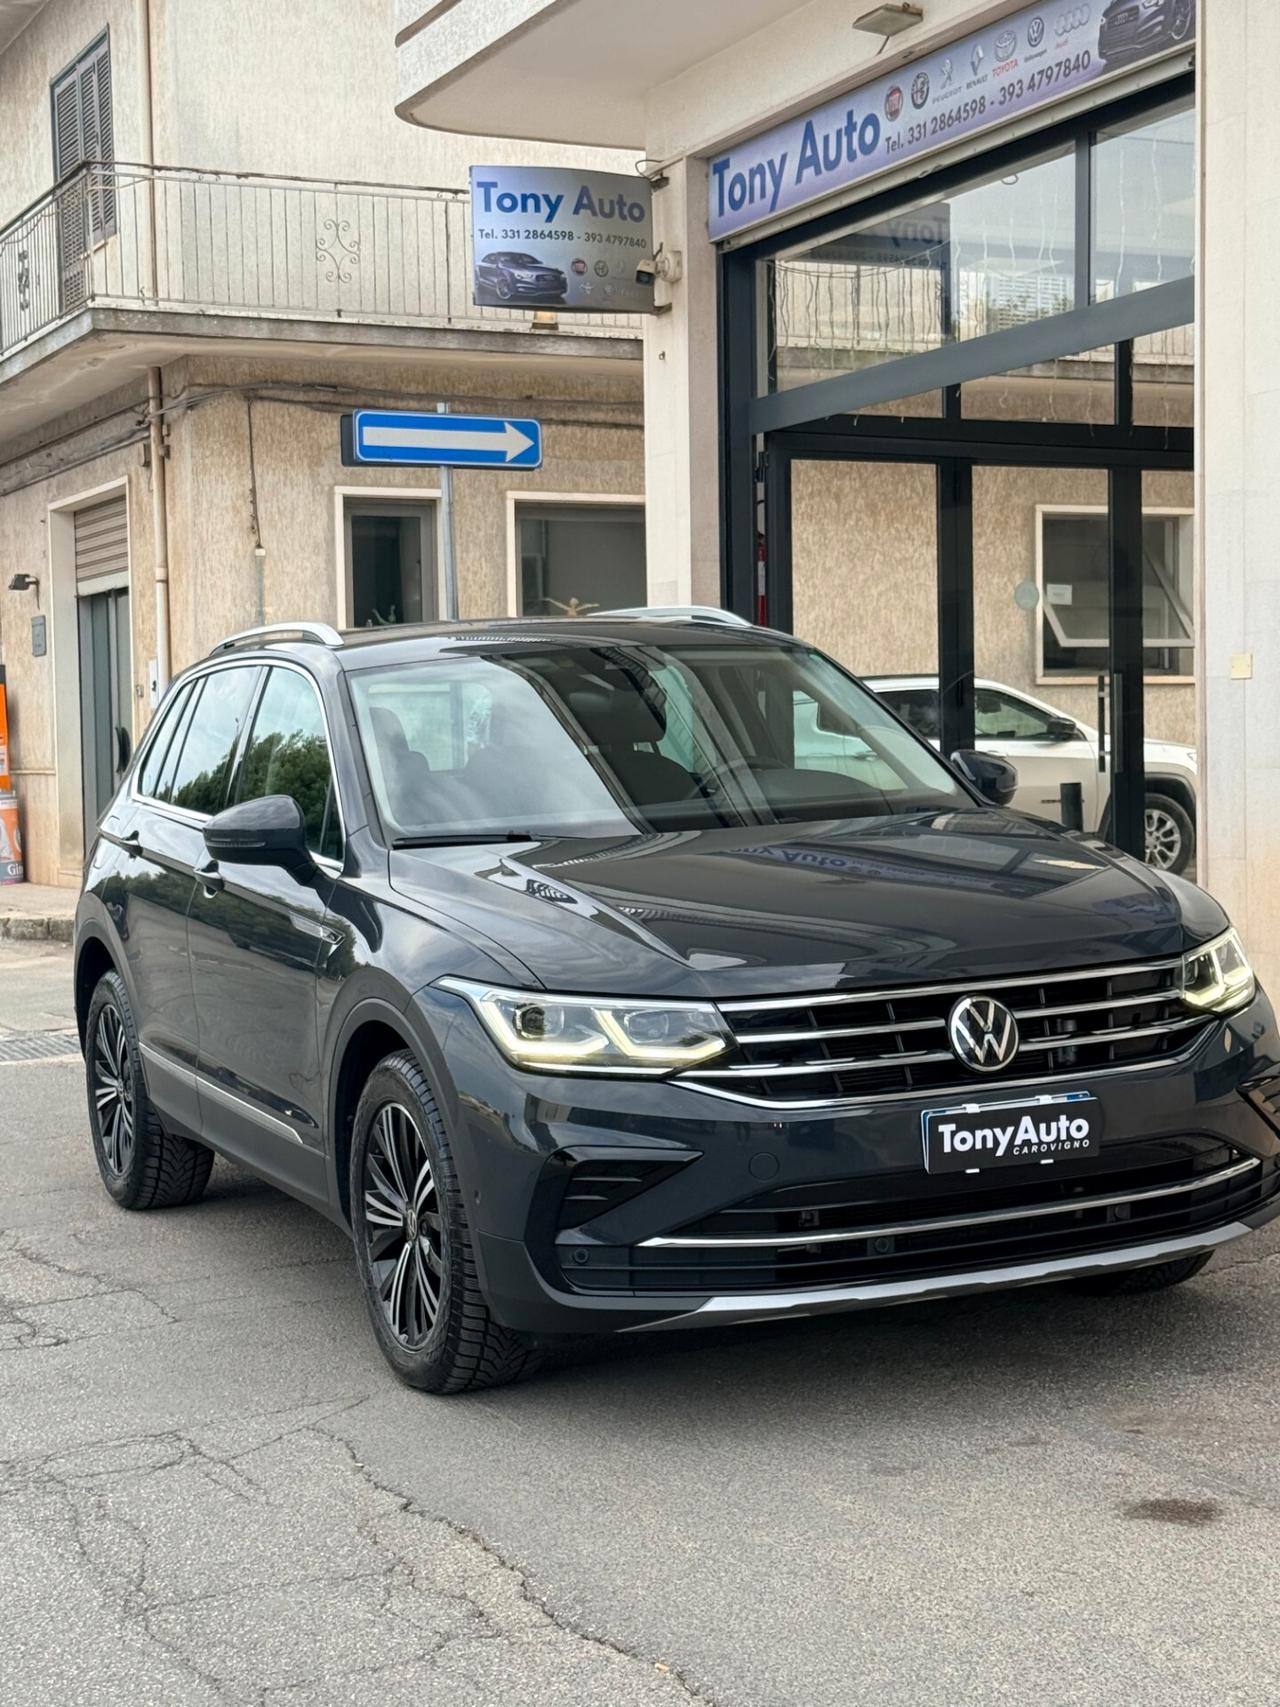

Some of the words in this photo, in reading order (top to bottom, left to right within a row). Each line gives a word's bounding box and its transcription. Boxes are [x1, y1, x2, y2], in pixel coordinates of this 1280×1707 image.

[992, 58, 1019, 77] TOYOTA
[885, 131, 904, 154] Tel.
[907, 121, 927, 145] 331
[930, 96, 986, 136] 2864598
[998, 79, 1024, 105] 393
[1027, 50, 1091, 92] 4797840
[712, 152, 788, 217] Tony
[795, 109, 881, 185] Auto
[477, 182, 564, 223] Tony
[572, 185, 646, 223] Auto
[478, 228, 498, 240] Tel.
[502, 229, 520, 240] 331
[524, 229, 574, 241] 2864598
[584, 232, 603, 244] 393
[605, 234, 647, 249] 4797840
[1013, 1139, 1090, 1156] CAROVIGNO
